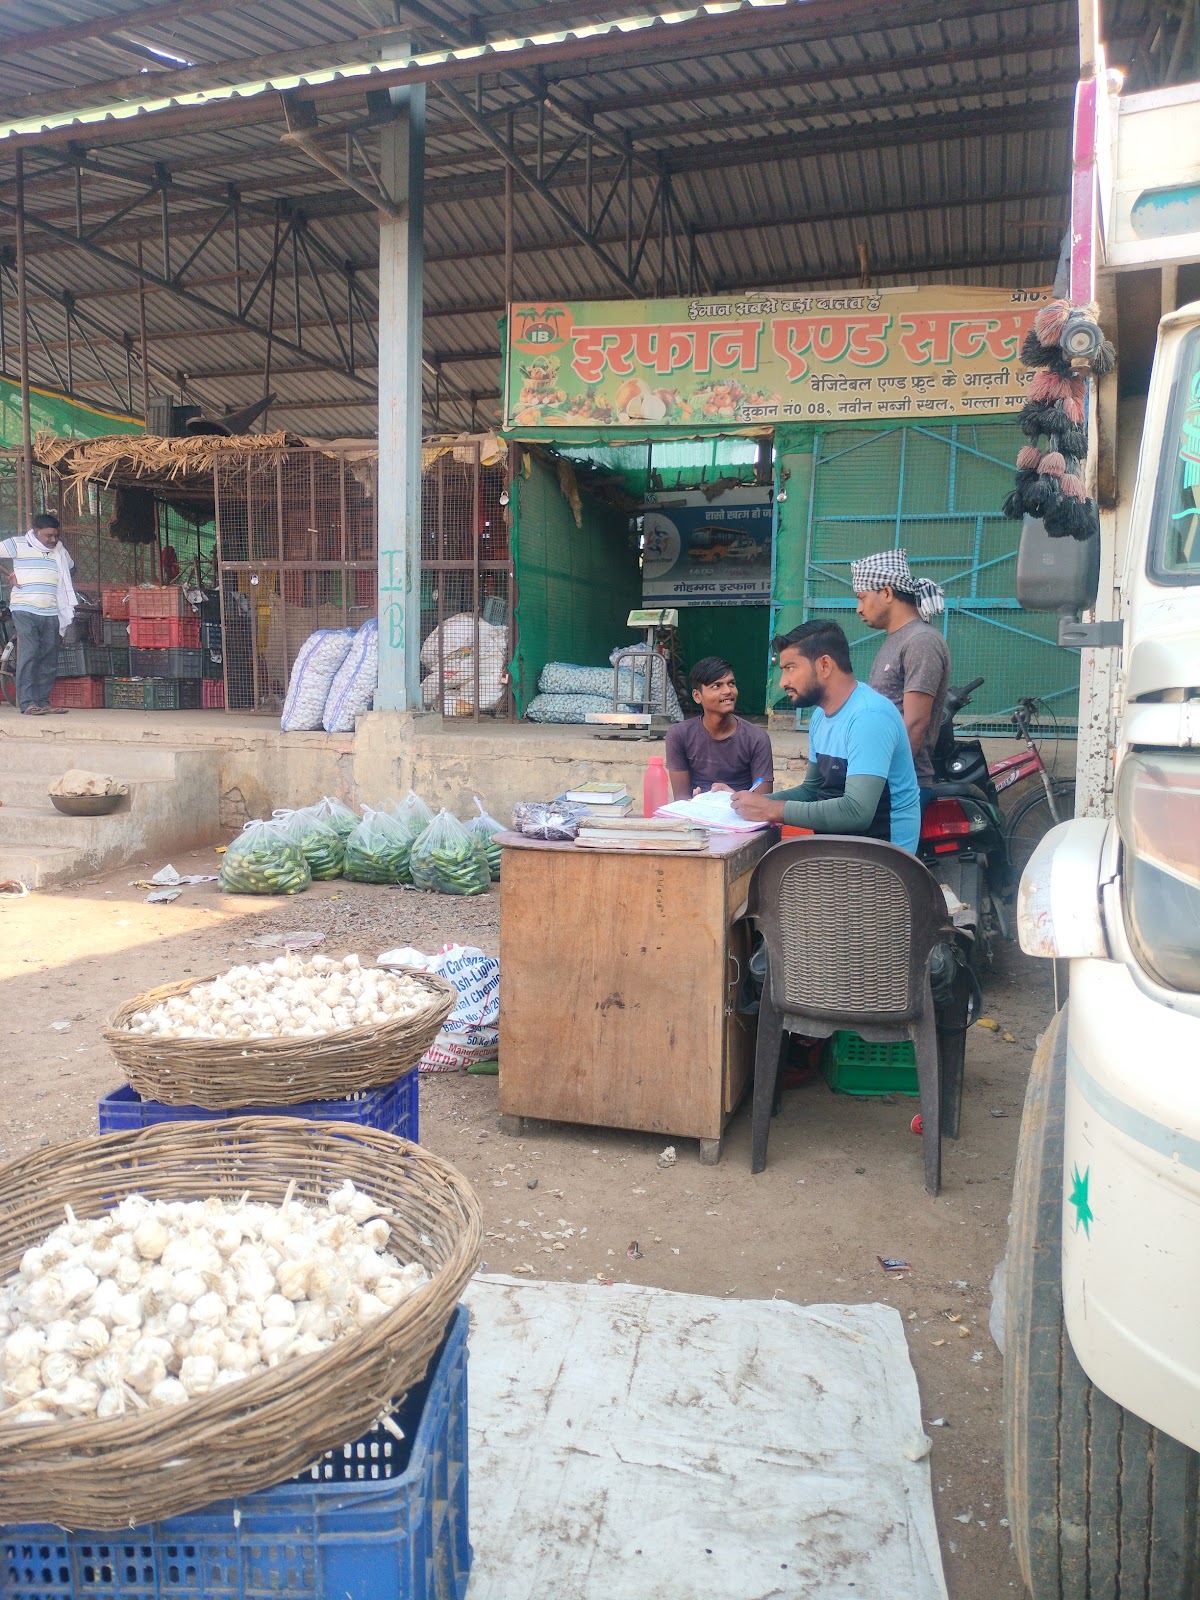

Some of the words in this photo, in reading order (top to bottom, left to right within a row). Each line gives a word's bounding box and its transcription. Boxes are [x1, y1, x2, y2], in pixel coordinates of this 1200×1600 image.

[689, 301, 732, 320] ईमान
[735, 298, 778, 316] सबसे
[531, 331, 549, 343] IB
[570, 321, 761, 383] इरफान
[772, 313, 890, 383] एण्ड
[810, 373, 873, 393] वेजिटेबल
[877, 376, 907, 394] एण्ड
[911, 374, 936, 394] फ्रुट
[941, 369, 958, 388] के
[962, 366, 1011, 391] आढ़ती
[741, 404, 779, 422] दुकान
[807, 403, 833, 417] 08,
[837, 397, 873, 414] नवीन
[877, 395, 912, 412] सब्जी
[916, 400, 955, 411] स्थल,
[961, 397, 1000, 409] गल्ला
[751, 507, 762, 519] हो
[673, 582, 717, 593] मोहम्मद
[719, 582, 757, 593] इरफान
[442, 1016, 466, 1033] Batch
[467, 1035, 478, 1045] 50
